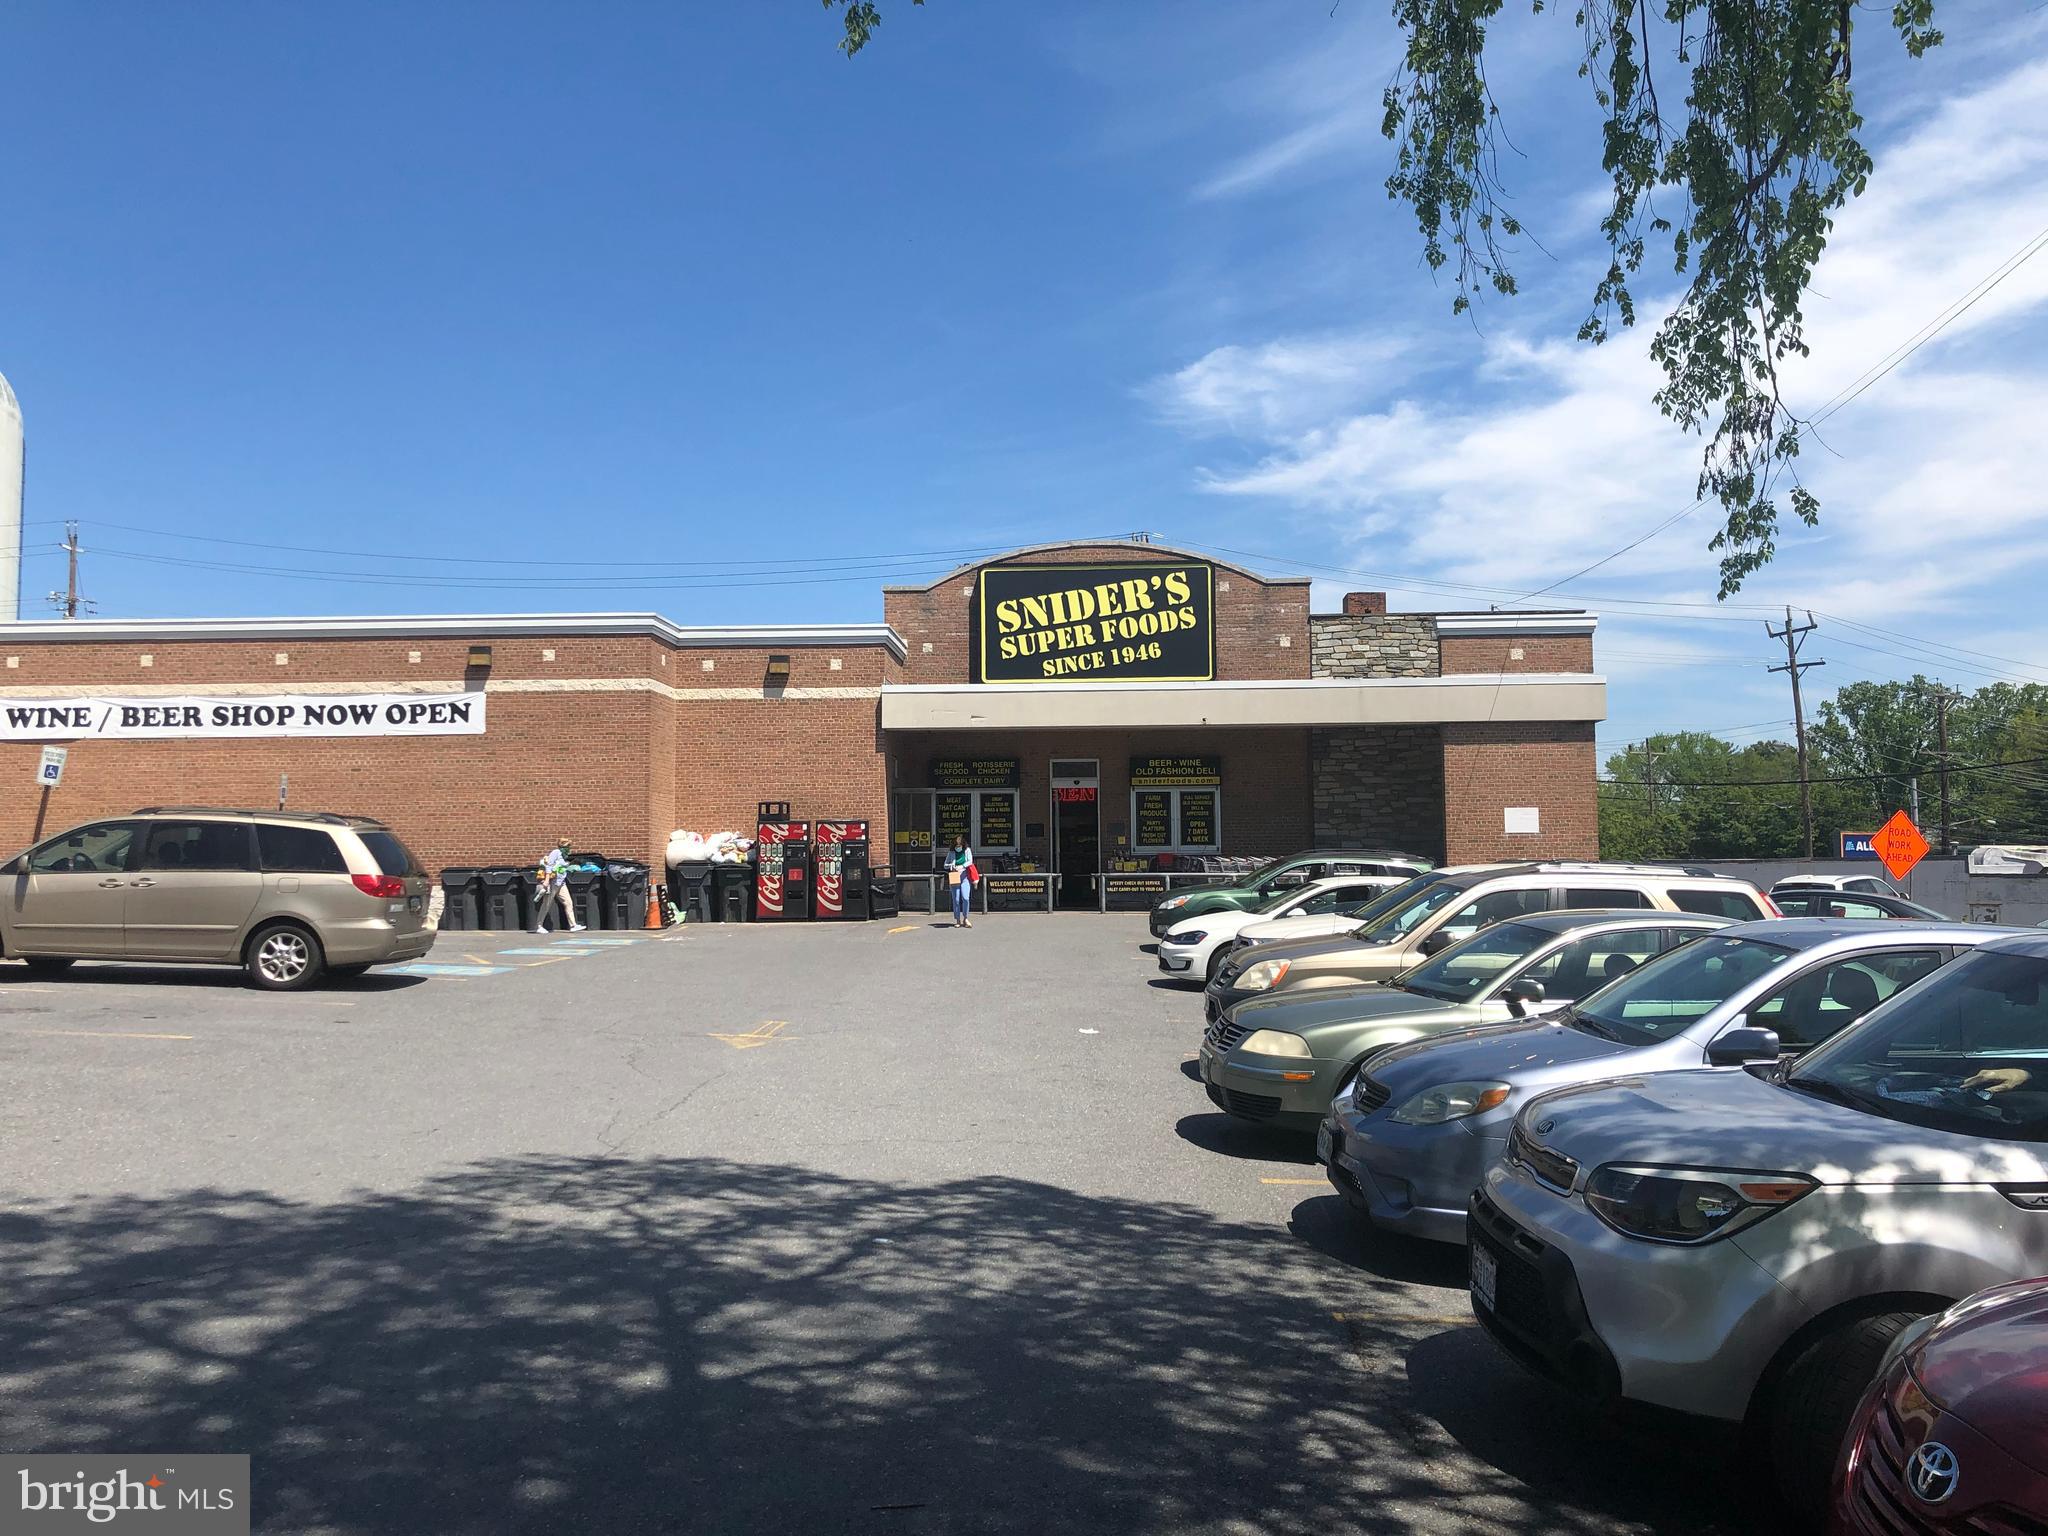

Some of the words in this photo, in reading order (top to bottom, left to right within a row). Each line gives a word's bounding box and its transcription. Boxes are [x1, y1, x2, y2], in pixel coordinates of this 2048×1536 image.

[995, 570, 1191, 634] SNIDER'S
[999, 623, 1096, 660] SUPER
[1100, 606, 1197, 644] FOODS
[1042, 650, 1105, 677] SINCE
[1112, 642, 1162, 666] 1946
[6, 707, 92, 728] WINE
[121, 706, 203, 727] BEER
[212, 705, 295, 727] SHOP
[303, 704, 378, 725] NOW
[385, 702, 471, 724] OPEN
[1149, 759, 1172, 767] BEER
[1889, 827, 1911, 837] ROAD
[1888, 841, 1911, 850] WORK
[1886, 853, 1913, 862] AHEAD
